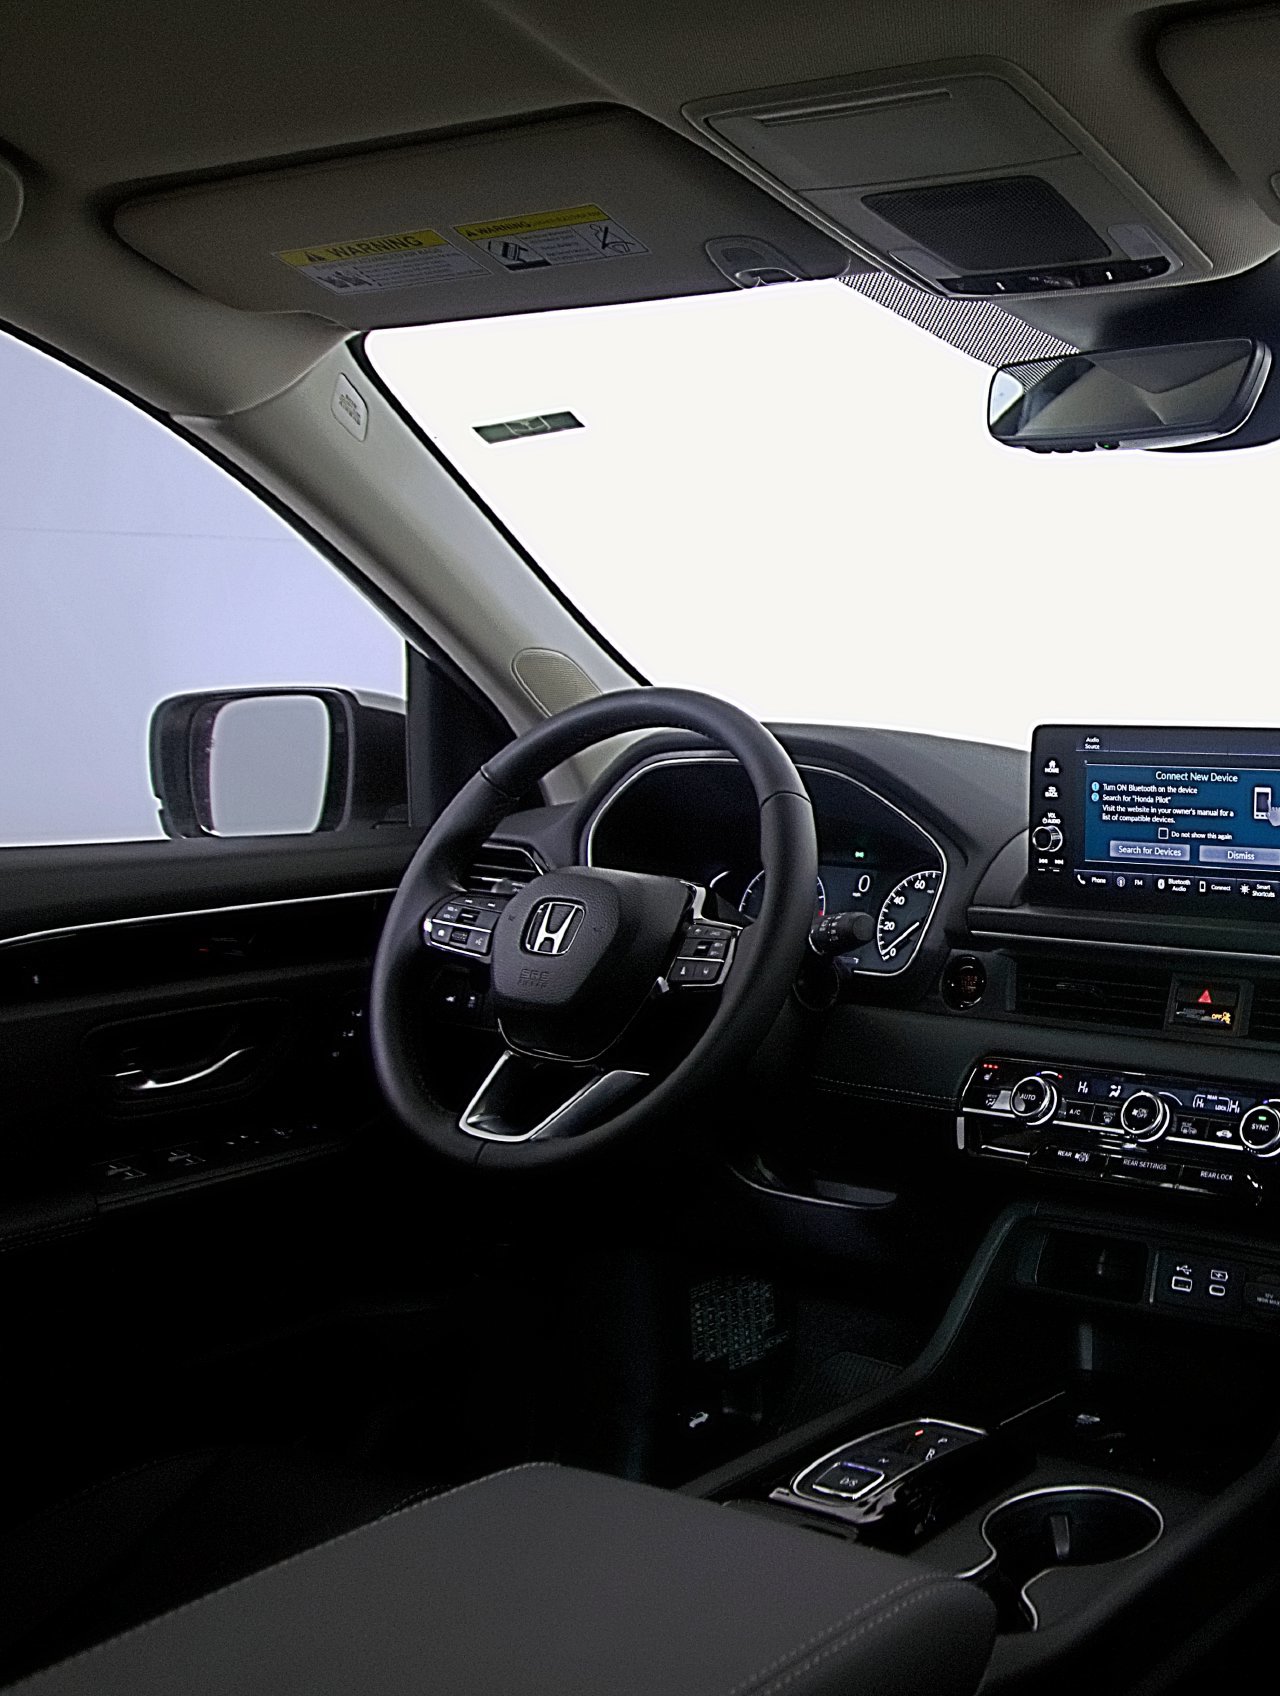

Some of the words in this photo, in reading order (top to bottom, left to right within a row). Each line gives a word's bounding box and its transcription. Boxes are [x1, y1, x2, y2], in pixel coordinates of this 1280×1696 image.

[327, 235, 424, 258] WARNING
[1155, 771, 1189, 781] Connect
[1189, 772, 1210, 782] New
[1210, 773, 1239, 783] Device
[1103, 783, 1117, 791] Turn
[1116, 784, 1128, 792] ON
[1128, 784, 1157, 793] Bluetooth
[1166, 786, 1177, 794] the
[1177, 786, 1198, 794] device
[1102, 794, 1122, 802] Search
[1122, 794, 1131, 802] for
[1116, 805, 1126, 813] the
[1150, 806, 1157, 814] in
[1157, 808, 1171, 816] your
[1172, 807, 1196, 815] owner's
[1196, 809, 1219, 817] manual
[1219, 809, 1229, 817] for
[1119, 814, 1151, 824] compatible
[1151, 815, 1176, 824] devices.
[1118, 845, 1141, 855] Search
[1142, 846, 1152, 855] for
[1154, 847, 1182, 857] Devices
[1227, 851, 1255, 861] Dismiss
[858, 874, 871, 893] 0
[914, 880, 926, 890] 60
[1091, 876, 1107, 884] Phone
[1168, 878, 1191, 886] Bluetooth
[1211, 884, 1231, 892] Connect
[1252, 890, 1276, 898] Shortcuts
[893, 895, 906, 906] 40
[883, 921, 896, 931] 20
[890, 948, 897, 957] 0
[1020, 1093, 1037, 1101] AUTO
[1069, 1108, 1081, 1116] A/C
[1214, 1104, 1227, 1112] LOCK
[1251, 1123, 1270, 1132] SYNC
[1057, 1150, 1072, 1158] REAR
[1123, 1159, 1139, 1167] REAR
[1138, 1161, 1167, 1171] SETTINGS
[1200, 1170, 1216, 1179] REAR
[1216, 1173, 1233, 1181] LOCK
[925, 1447, 936, 1461] R
